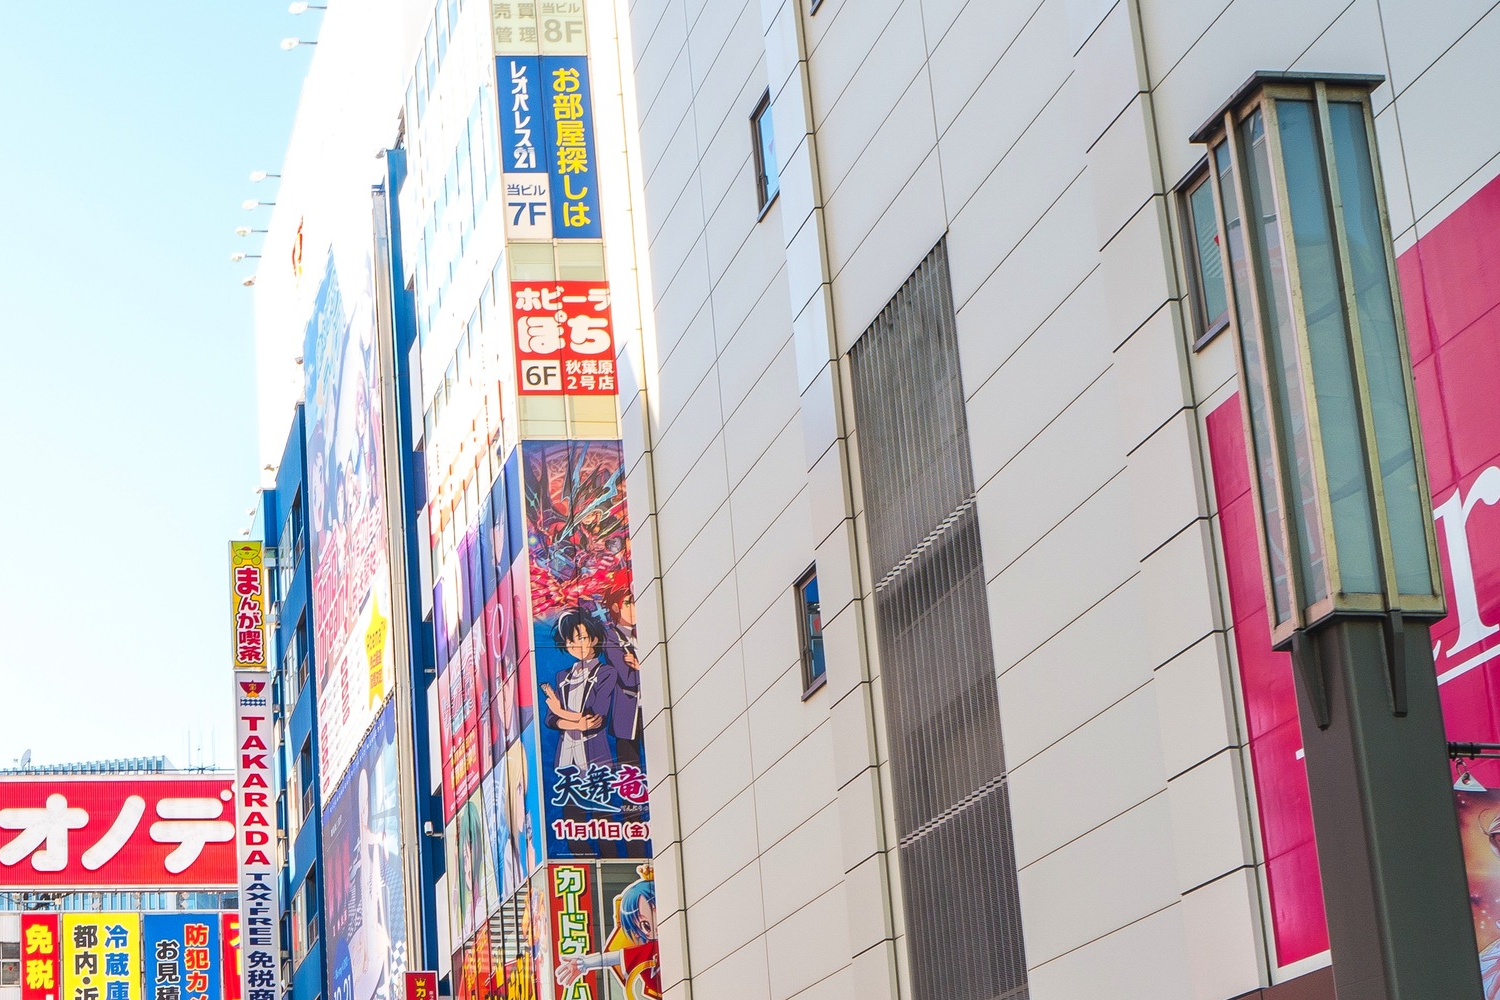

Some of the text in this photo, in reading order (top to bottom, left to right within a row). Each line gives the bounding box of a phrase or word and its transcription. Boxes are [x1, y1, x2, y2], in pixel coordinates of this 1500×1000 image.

[544, 19, 583, 44] 8F
[510, 60, 536, 169] レオパレス21
[552, 67, 591, 228] お部屋探しは
[507, 184, 545, 197] 当ビル
[508, 202, 547, 226] 7F
[517, 312, 611, 354] ぽち
[526, 365, 557, 390] 6F
[565, 360, 614, 376] 秋葉原
[566, 376, 614, 391] 2号店
[234, 565, 265, 665] まんが喫茶
[239, 716, 272, 867] TAKARADA
[552, 819, 650, 842] 11月11日(金)
[25, 923, 55, 990] 免税
